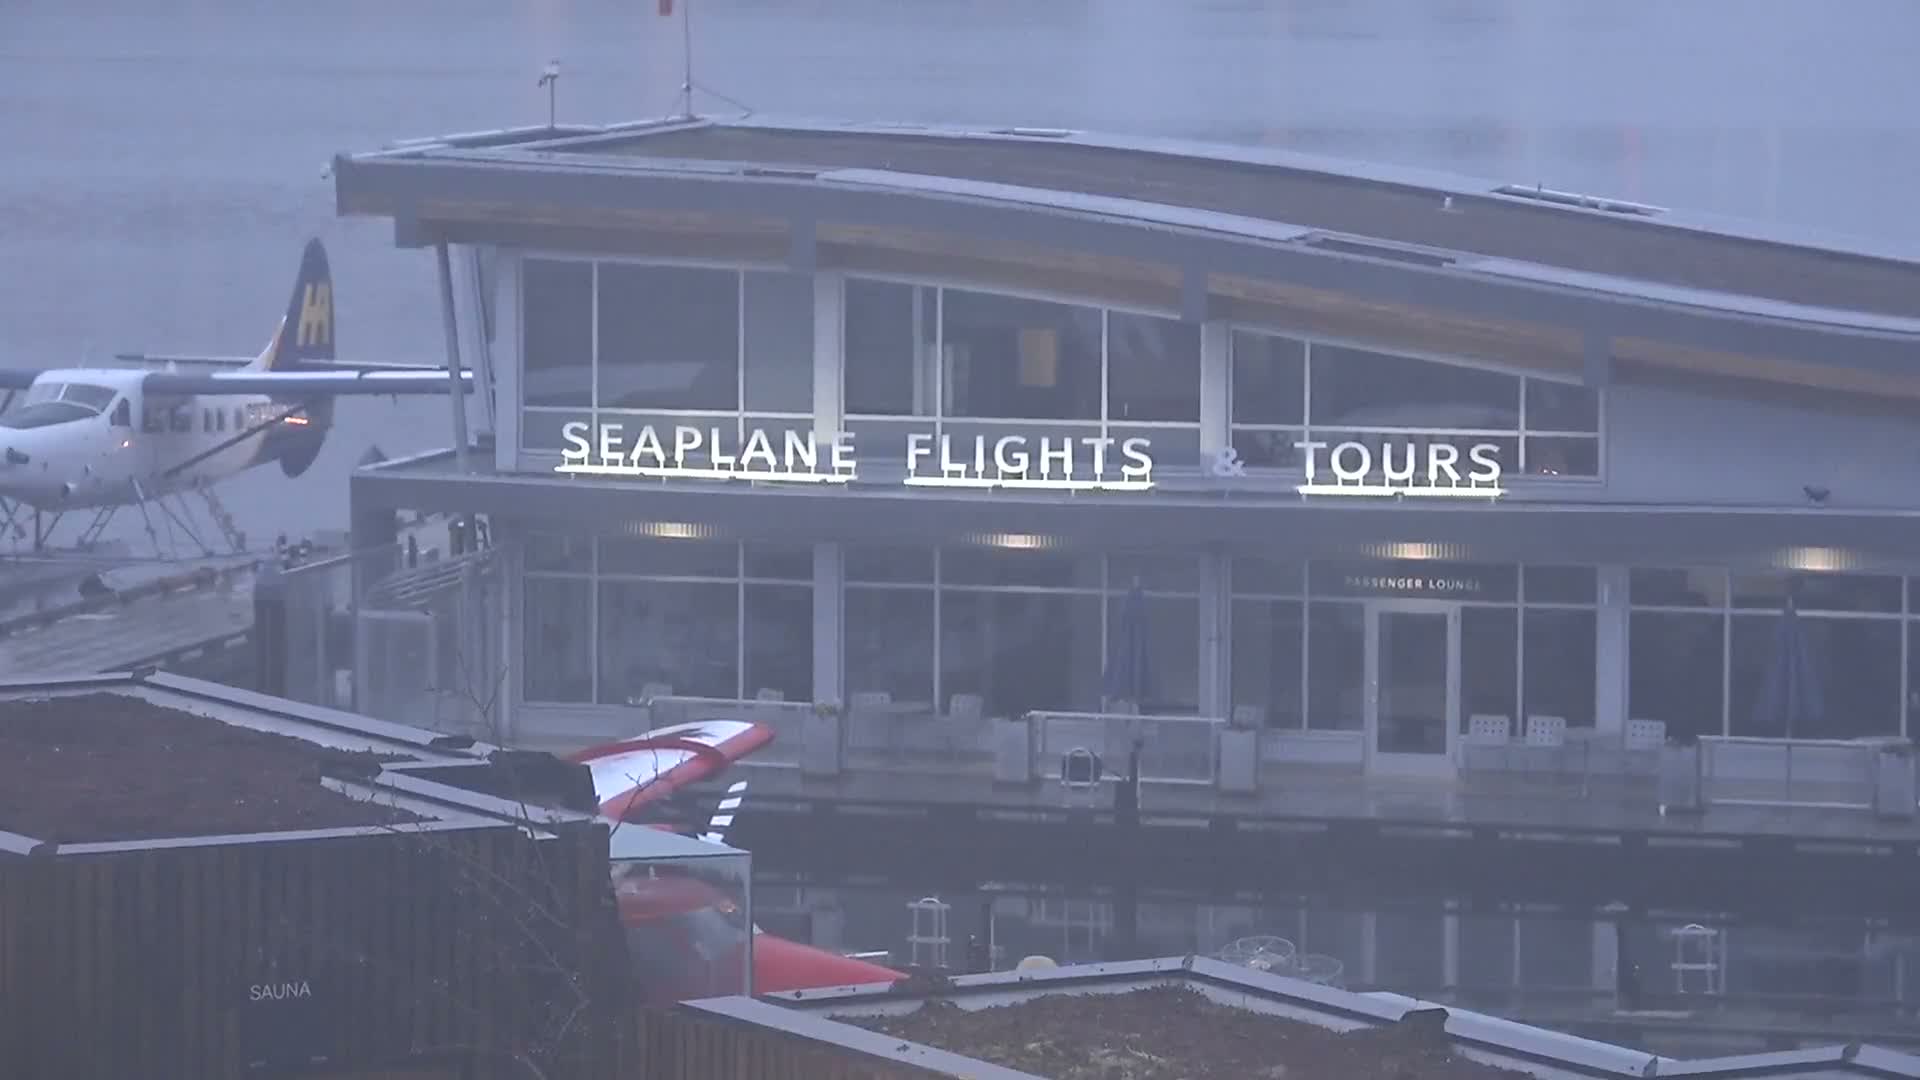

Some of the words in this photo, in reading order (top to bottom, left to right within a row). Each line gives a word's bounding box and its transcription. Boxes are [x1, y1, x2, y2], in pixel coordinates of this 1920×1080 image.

[561, 422, 857, 468] SEAPLANE
[907, 434, 1153, 474] FLIGHTS
[1212, 447, 1247, 477] &
[1294, 442, 1502, 481] TOURS
[1345, 576, 1423, 589] PASSENGER
[1429, 579, 1481, 591] LOUNGE
[249, 981, 312, 1001] SAUNA
